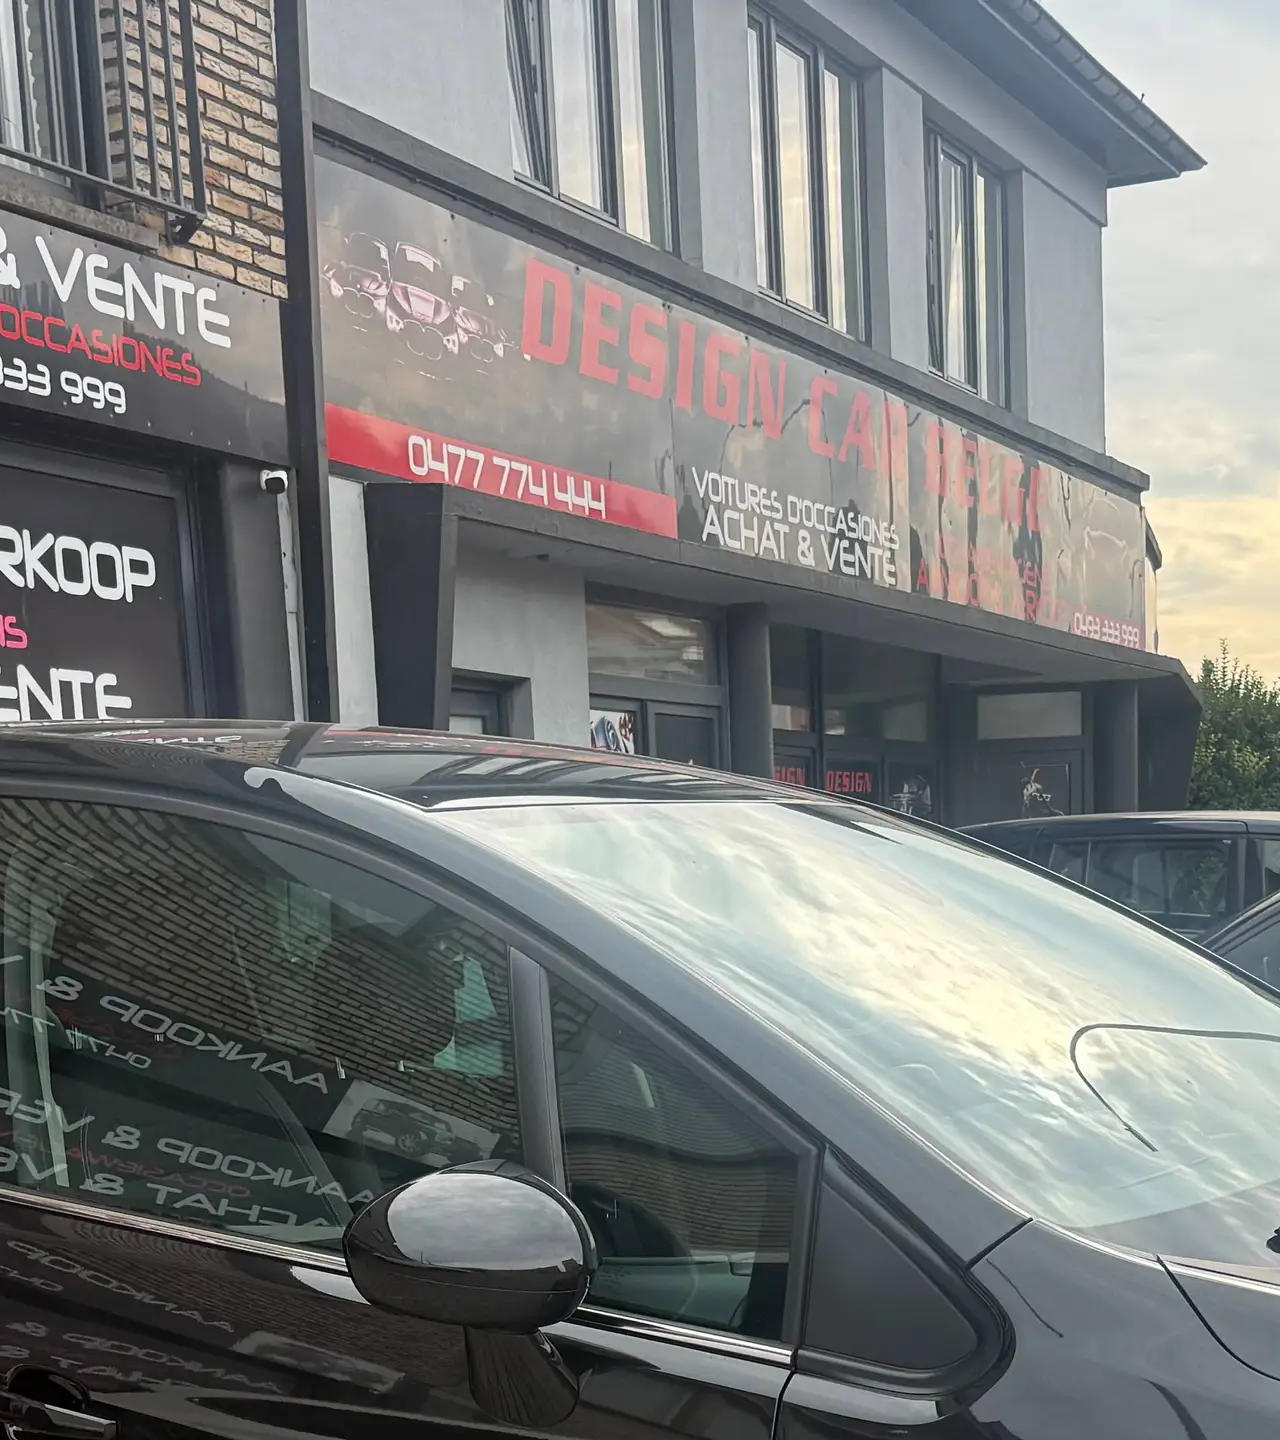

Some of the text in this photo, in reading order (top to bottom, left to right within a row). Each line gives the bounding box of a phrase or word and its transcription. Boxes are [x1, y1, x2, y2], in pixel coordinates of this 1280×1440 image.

[35, 235, 232, 348] VENTE
[521, 258, 787, 440] DESIGN
[60, 370, 126, 413] 999
[408, 435, 607, 519] 0477 774 444
[692, 467, 899, 550] VOITURES D'OCCASIONES
[702, 504, 789, 560] ACHAT
[797, 529, 815, 567] &
[821, 534, 897, 586] VENTE
[826, 770, 873, 794] DESIGN
